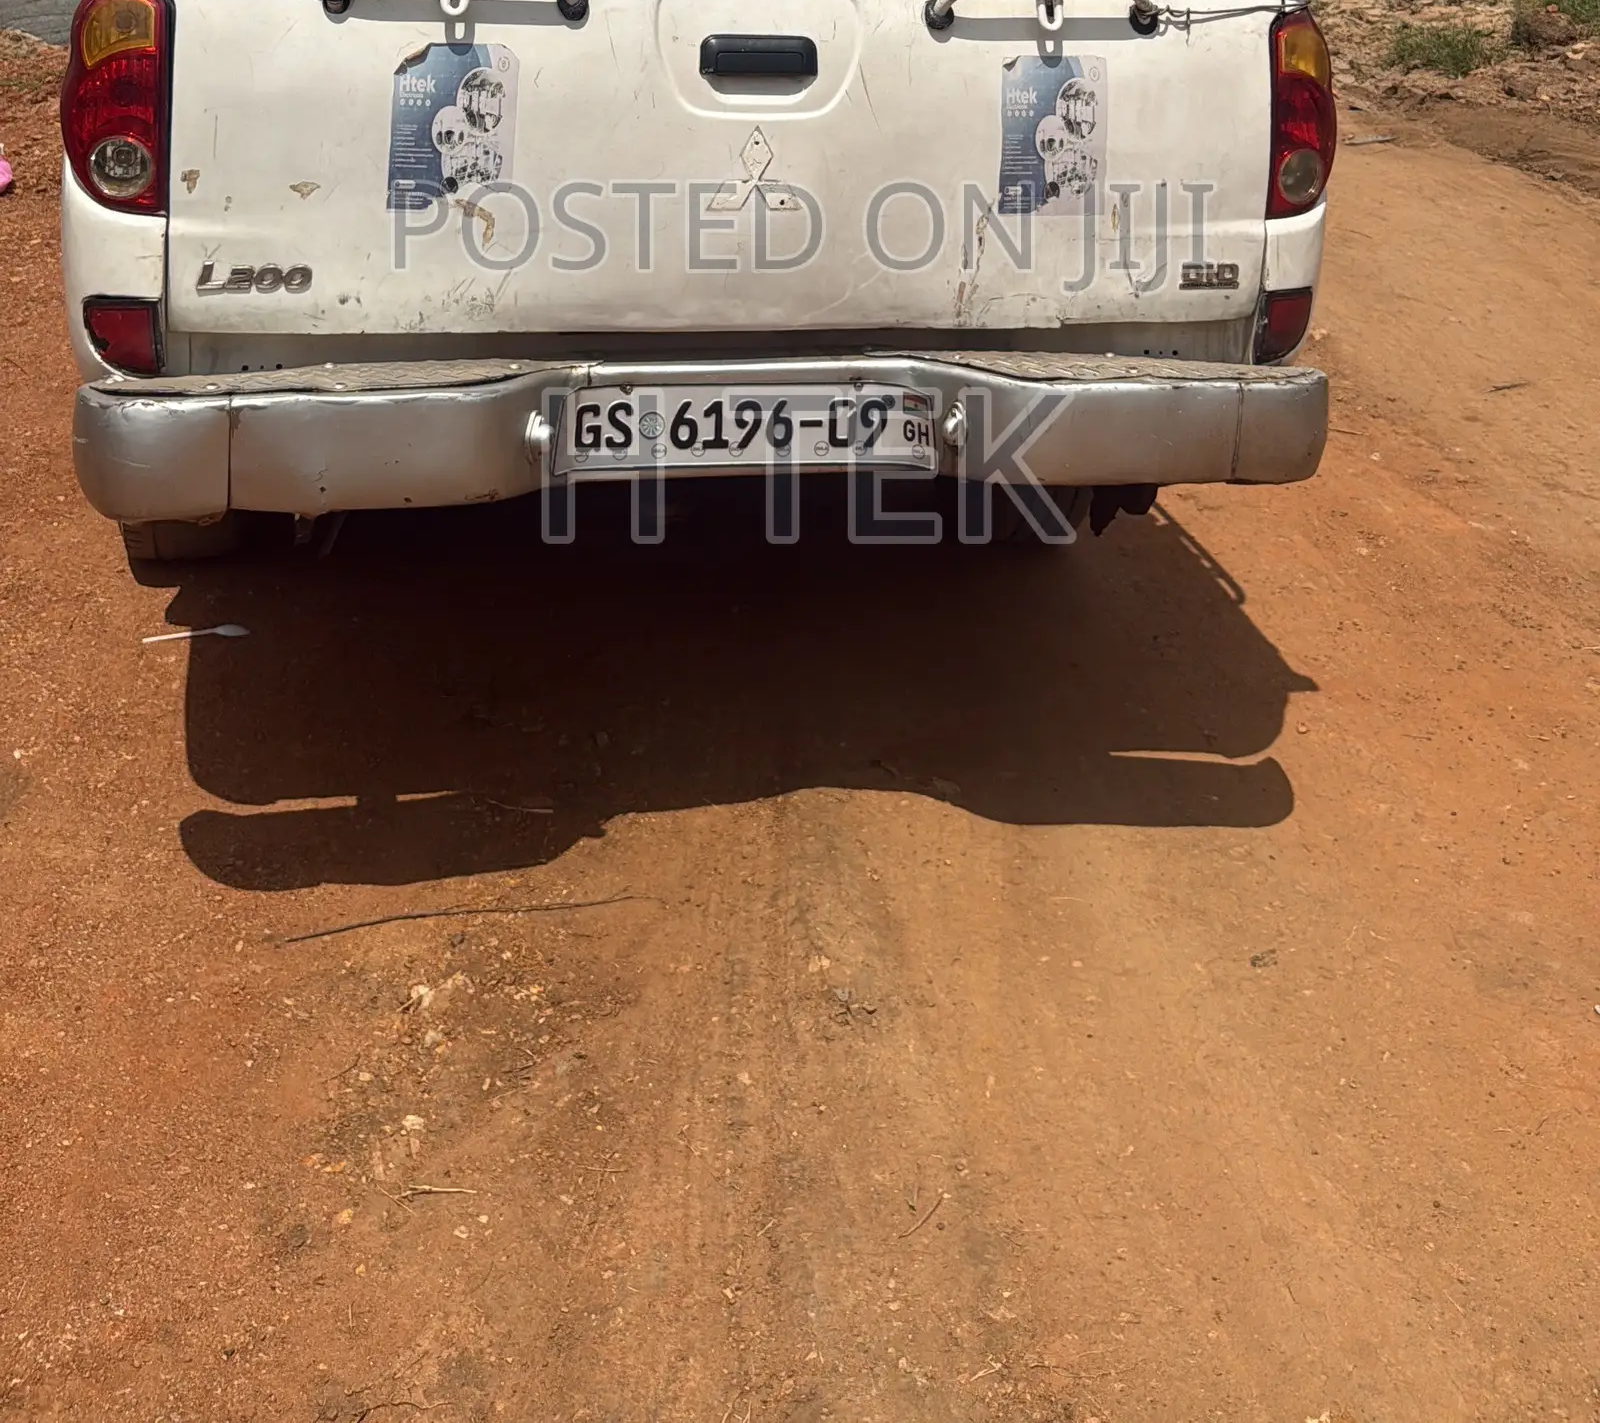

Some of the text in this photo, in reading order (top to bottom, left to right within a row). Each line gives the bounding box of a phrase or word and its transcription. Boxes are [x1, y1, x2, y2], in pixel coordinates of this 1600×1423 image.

[400, 74, 435, 92] Htek
[1006, 86, 1037, 104] Htek
[196, 259, 313, 295] L200
[574, 398, 889, 451] GS 6196-09
[903, 419, 931, 446] GH
